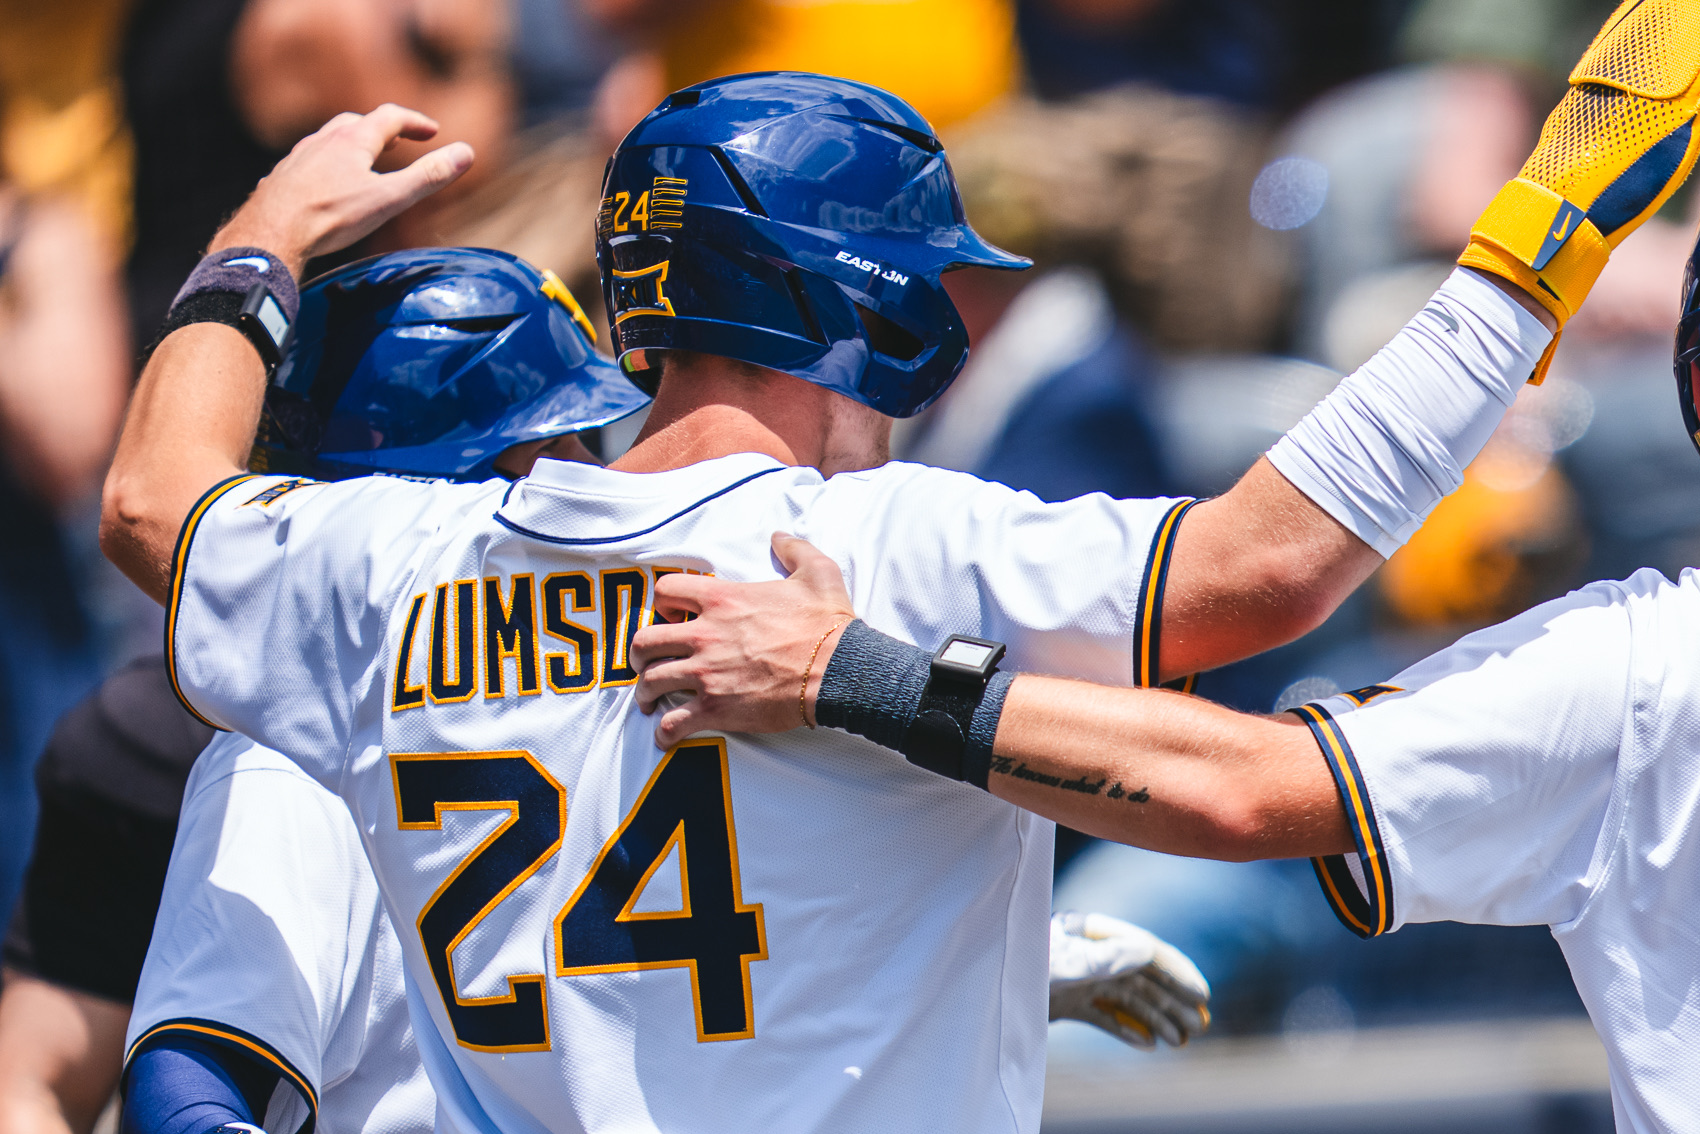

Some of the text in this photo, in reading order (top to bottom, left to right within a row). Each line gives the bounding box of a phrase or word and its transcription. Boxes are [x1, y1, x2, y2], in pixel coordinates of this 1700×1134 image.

[614, 190, 649, 233] 24
[834, 250, 910, 286] EASTON
[391, 565, 716, 713] LUMSD
[388, 736, 769, 1054] 24
